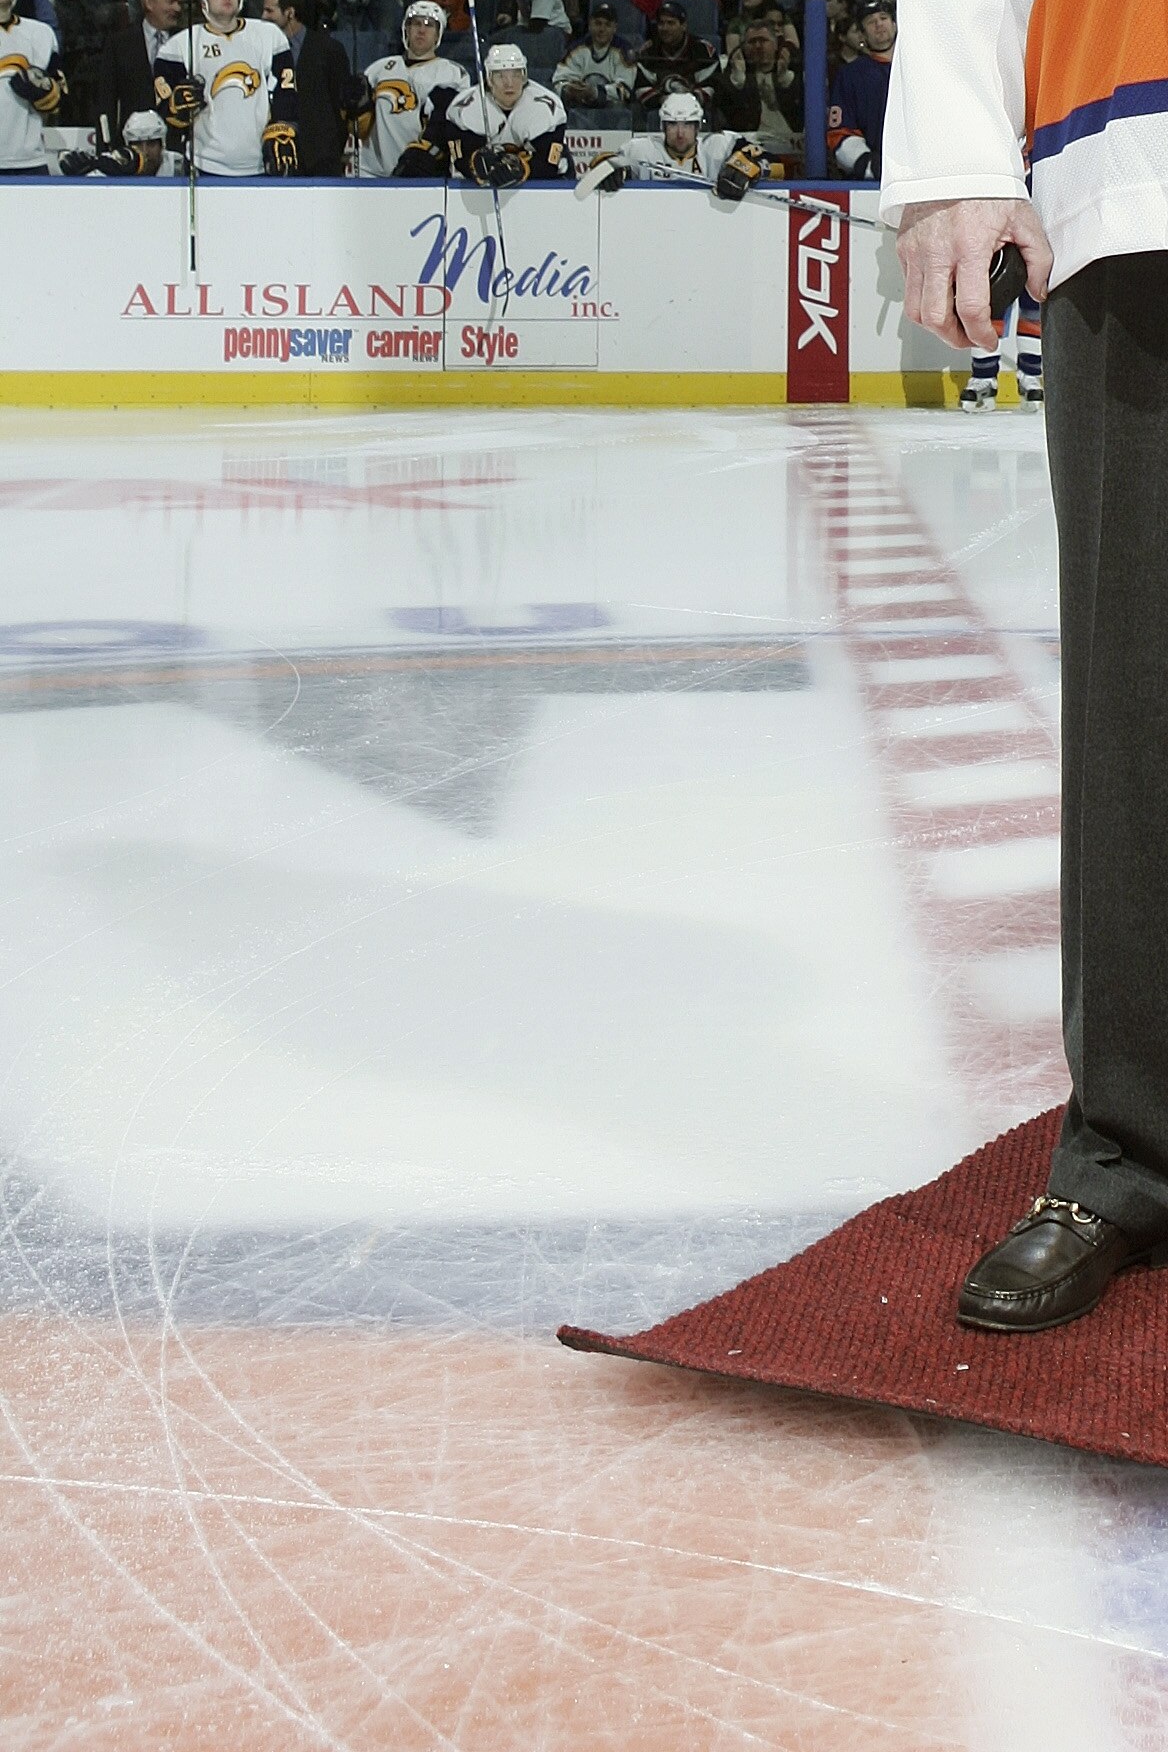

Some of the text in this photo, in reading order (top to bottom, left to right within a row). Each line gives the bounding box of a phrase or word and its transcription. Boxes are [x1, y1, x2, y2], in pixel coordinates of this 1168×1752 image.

[203, 44, 221, 58] 26
[692, 157, 702, 174] A
[410, 214, 598, 303] Media
[121, 283, 453, 317] ALL ISLAND
[571, 295, 619, 318] inc.
[224, 325, 519, 366] pennysaver carrier Style
[321, 354, 439, 364] NEWS NEWS
